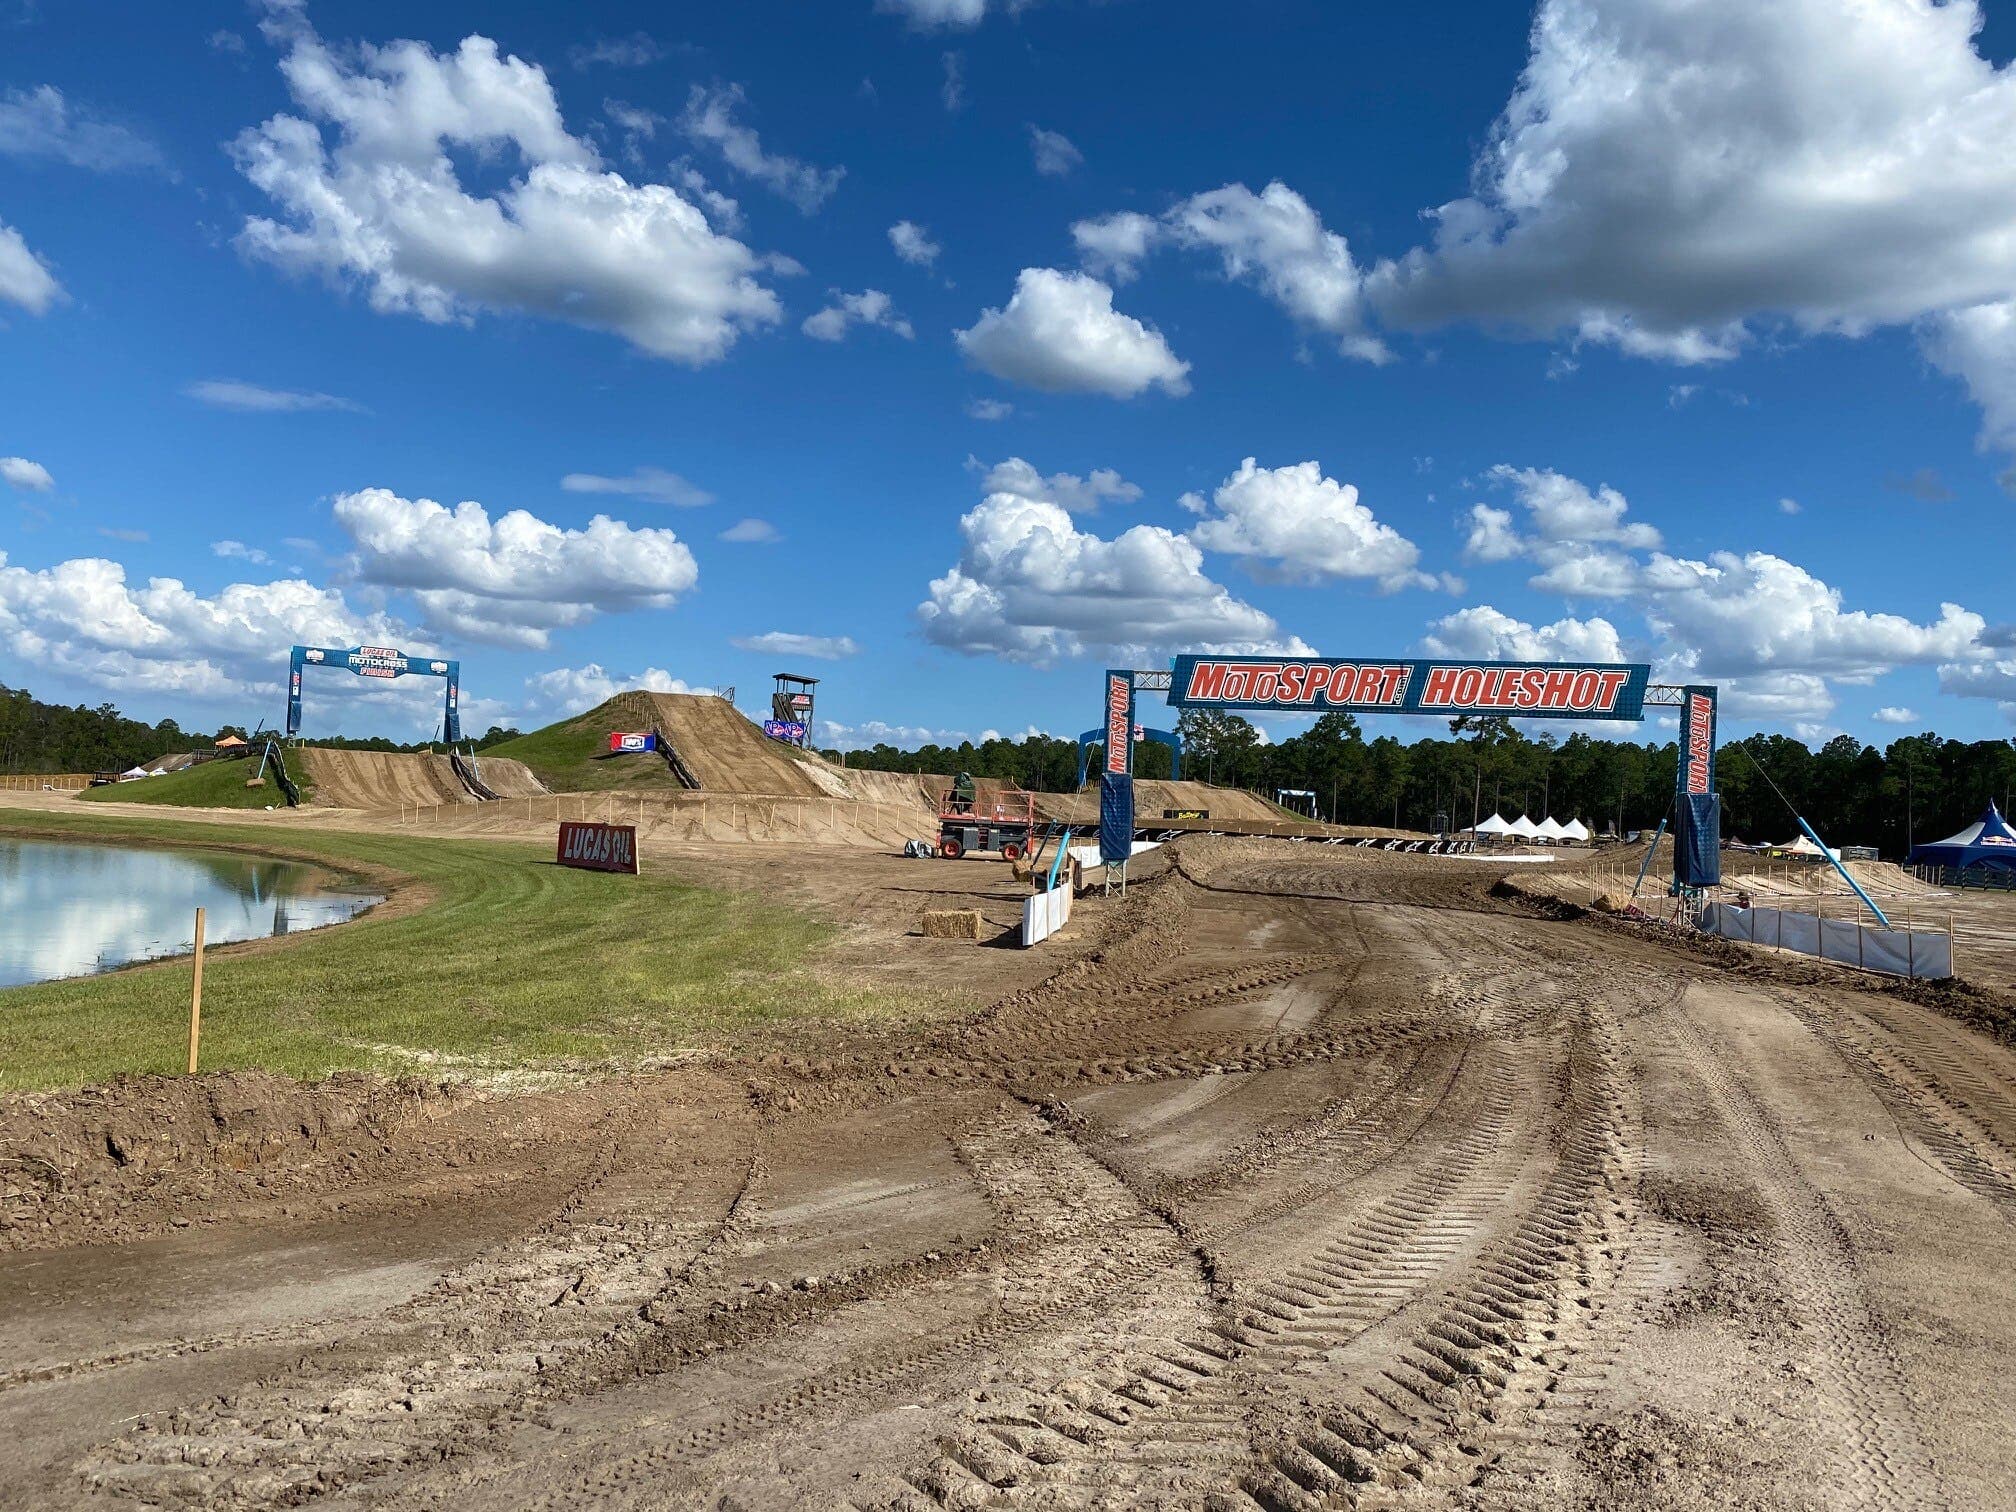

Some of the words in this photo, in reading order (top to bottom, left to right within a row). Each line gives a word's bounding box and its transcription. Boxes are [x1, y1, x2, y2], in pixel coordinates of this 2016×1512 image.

[348, 656, 408, 668] MOTOCROSS
[362, 648, 385, 656] LUCAS
[1421, 667, 1629, 711] HOLESHOT
[564, 827, 611, 863] LUCAS
[612, 829, 632, 865] OIL
